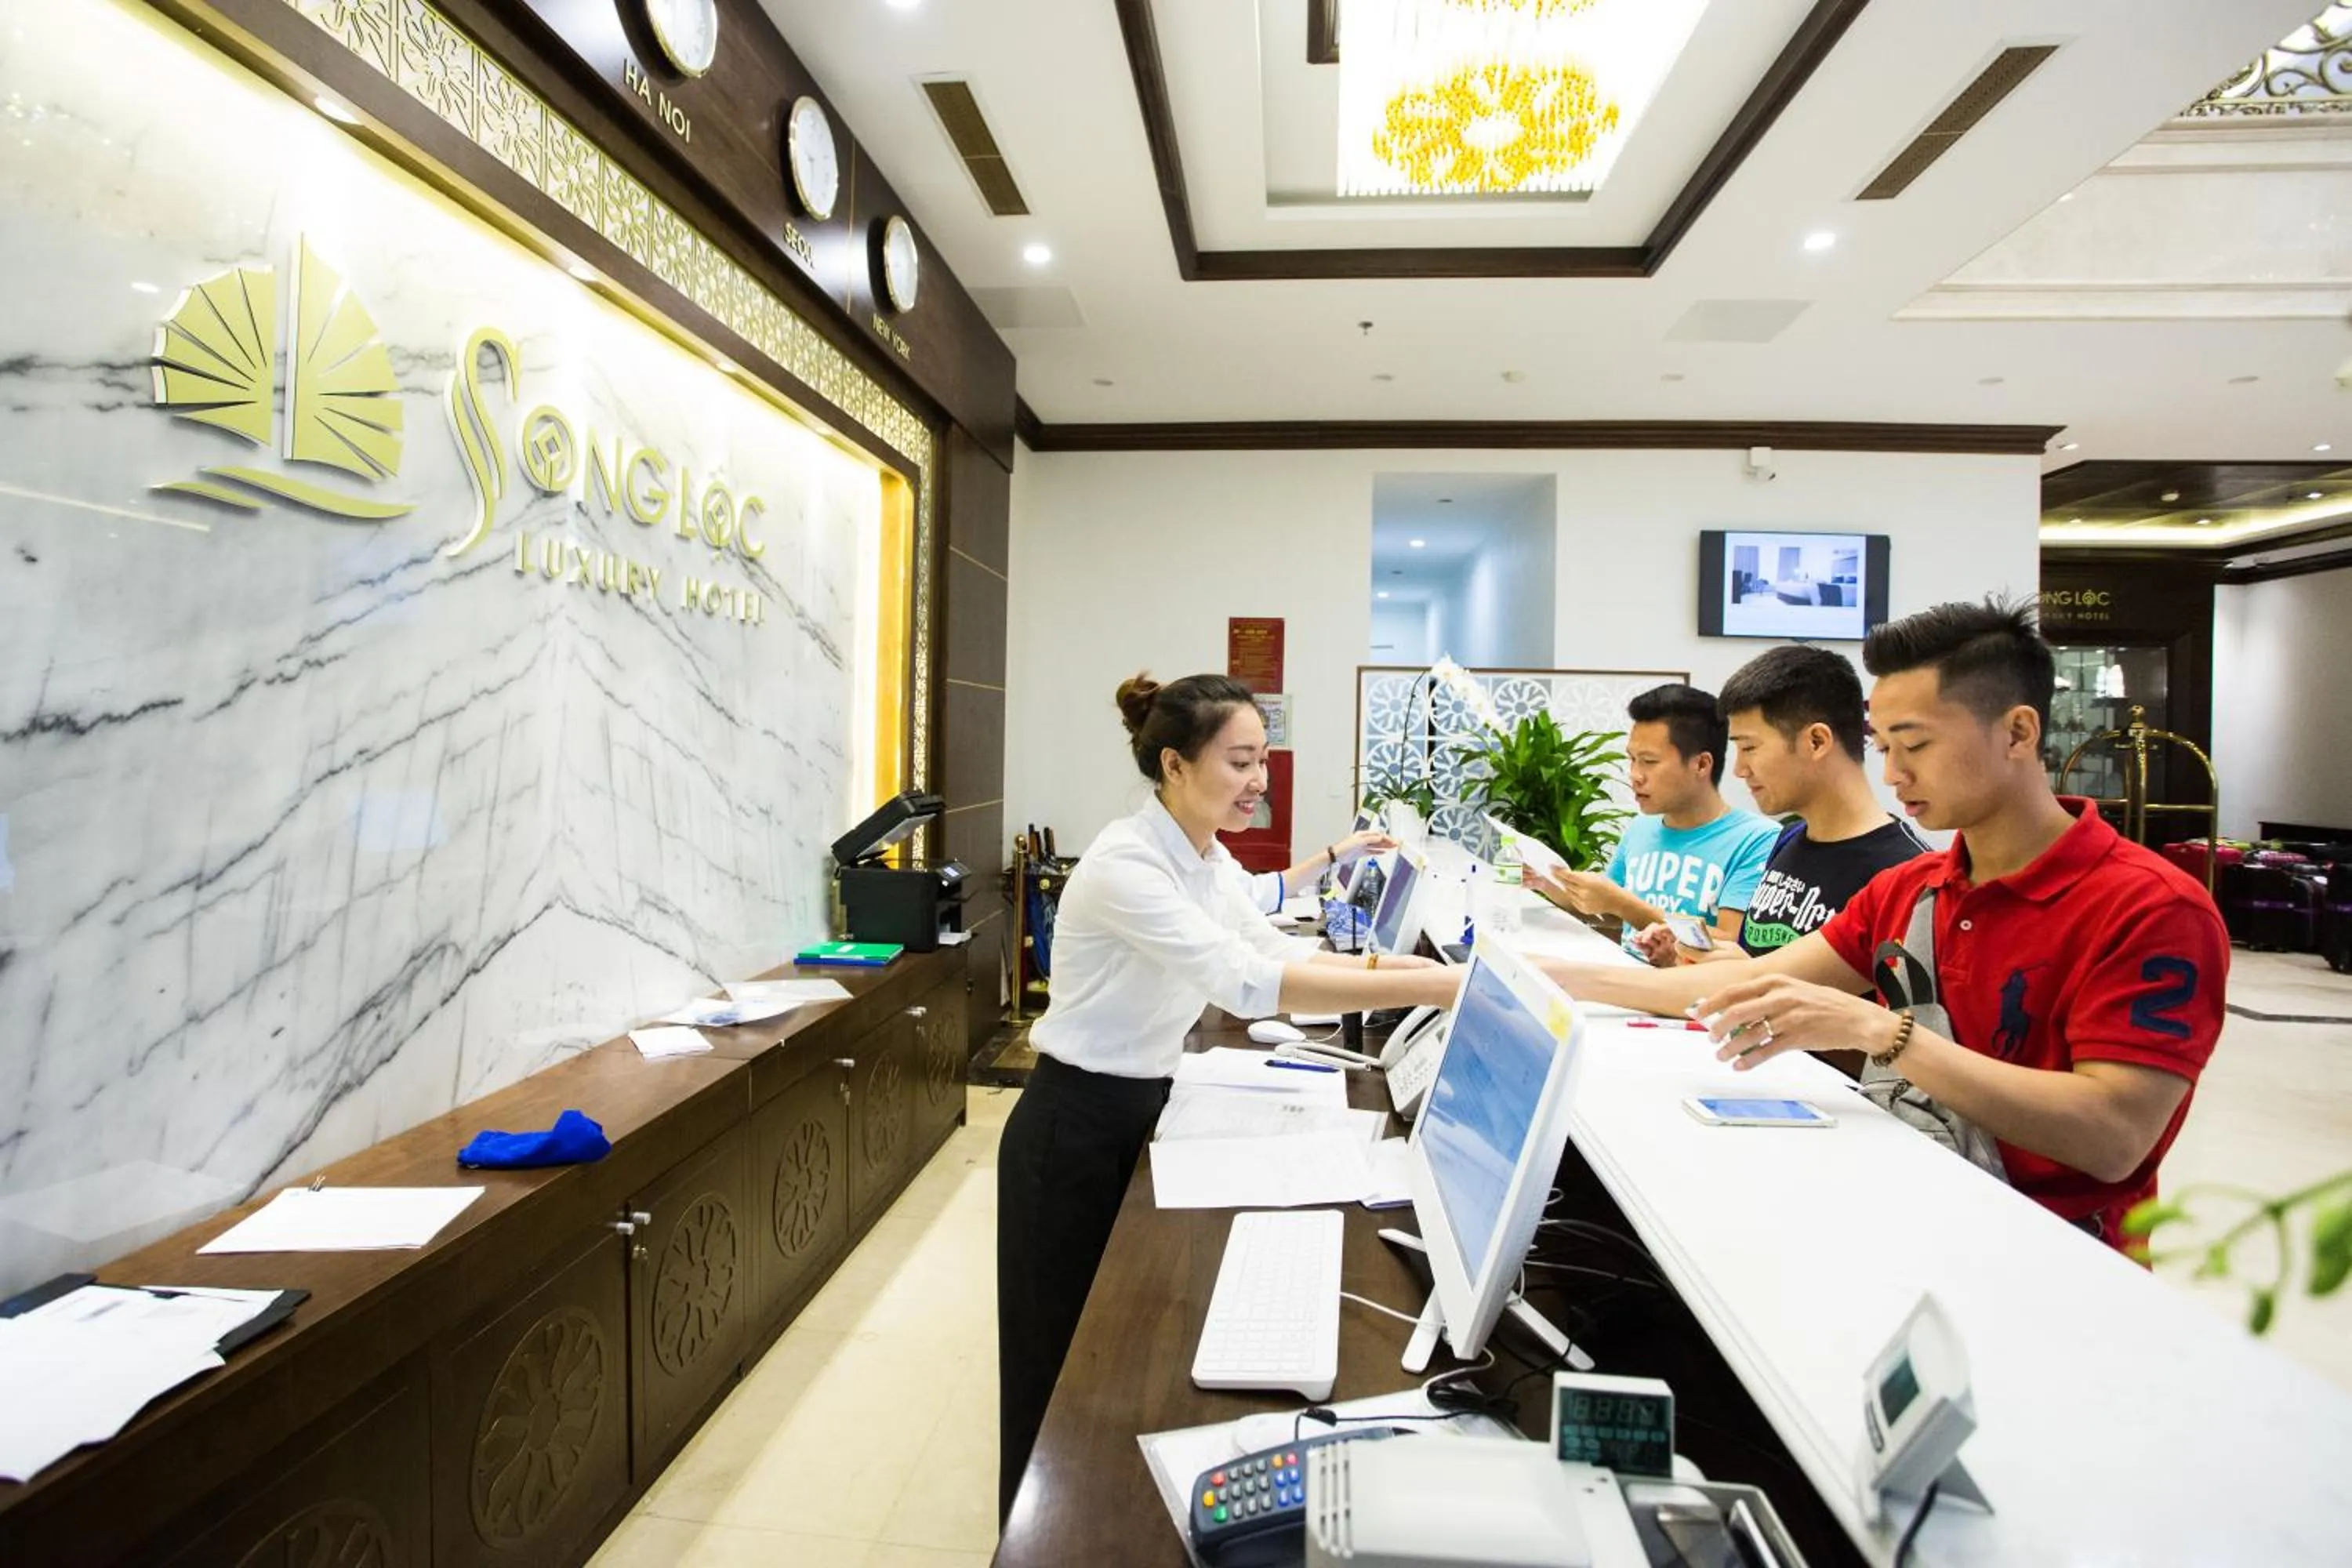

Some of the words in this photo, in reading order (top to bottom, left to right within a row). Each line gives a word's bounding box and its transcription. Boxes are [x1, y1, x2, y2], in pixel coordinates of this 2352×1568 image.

[624, 57, 652, 107] HA
[659, 91, 690, 143] NOI
[872, 314, 891, 341] NEW
[891, 331, 911, 362] YORK
[514, 529, 660, 601] LUXURY
[681, 575, 765, 626] HOTEL
[2077, 612, 2110, 621] HOTEL
[1625, 851, 1725, 916] SUPER
[2130, 956, 2198, 1040] 2
